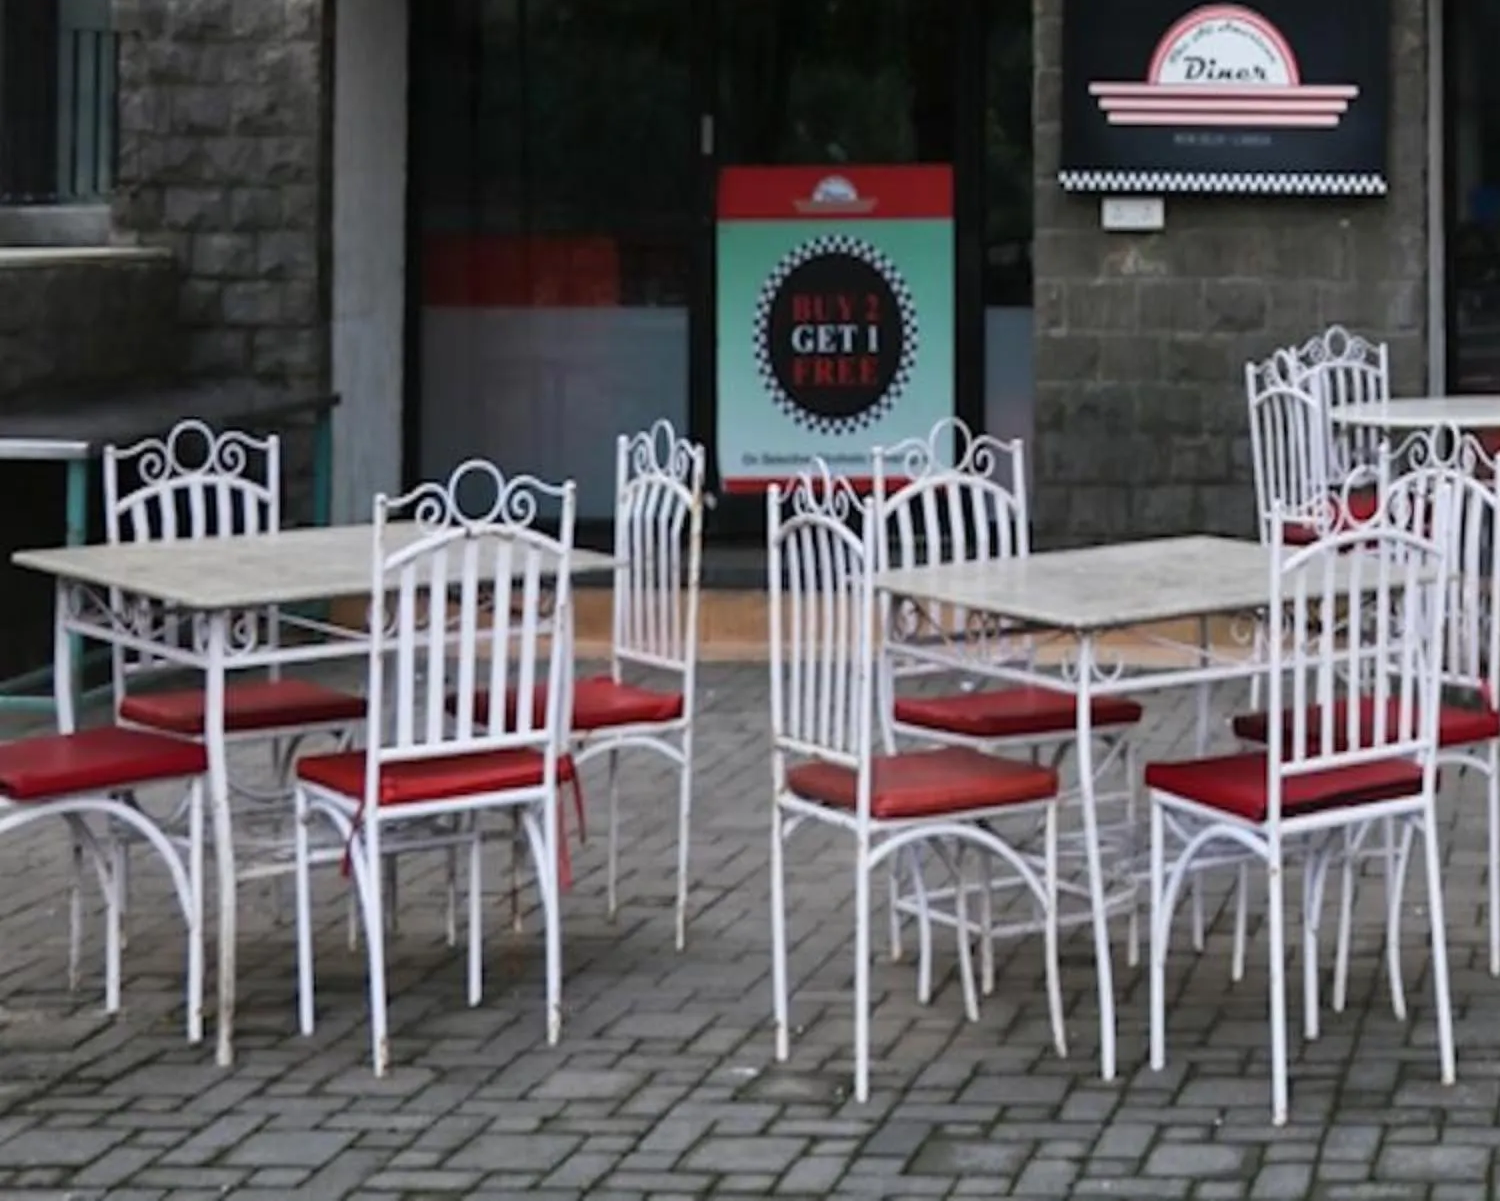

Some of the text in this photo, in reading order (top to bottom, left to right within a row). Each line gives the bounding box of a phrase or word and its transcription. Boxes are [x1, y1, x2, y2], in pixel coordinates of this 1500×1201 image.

[1183, 56, 1267, 80] Diner
[792, 295, 880, 322] BUY 2
[791, 325, 880, 354] GET 1
[792, 358, 879, 386] FREE
